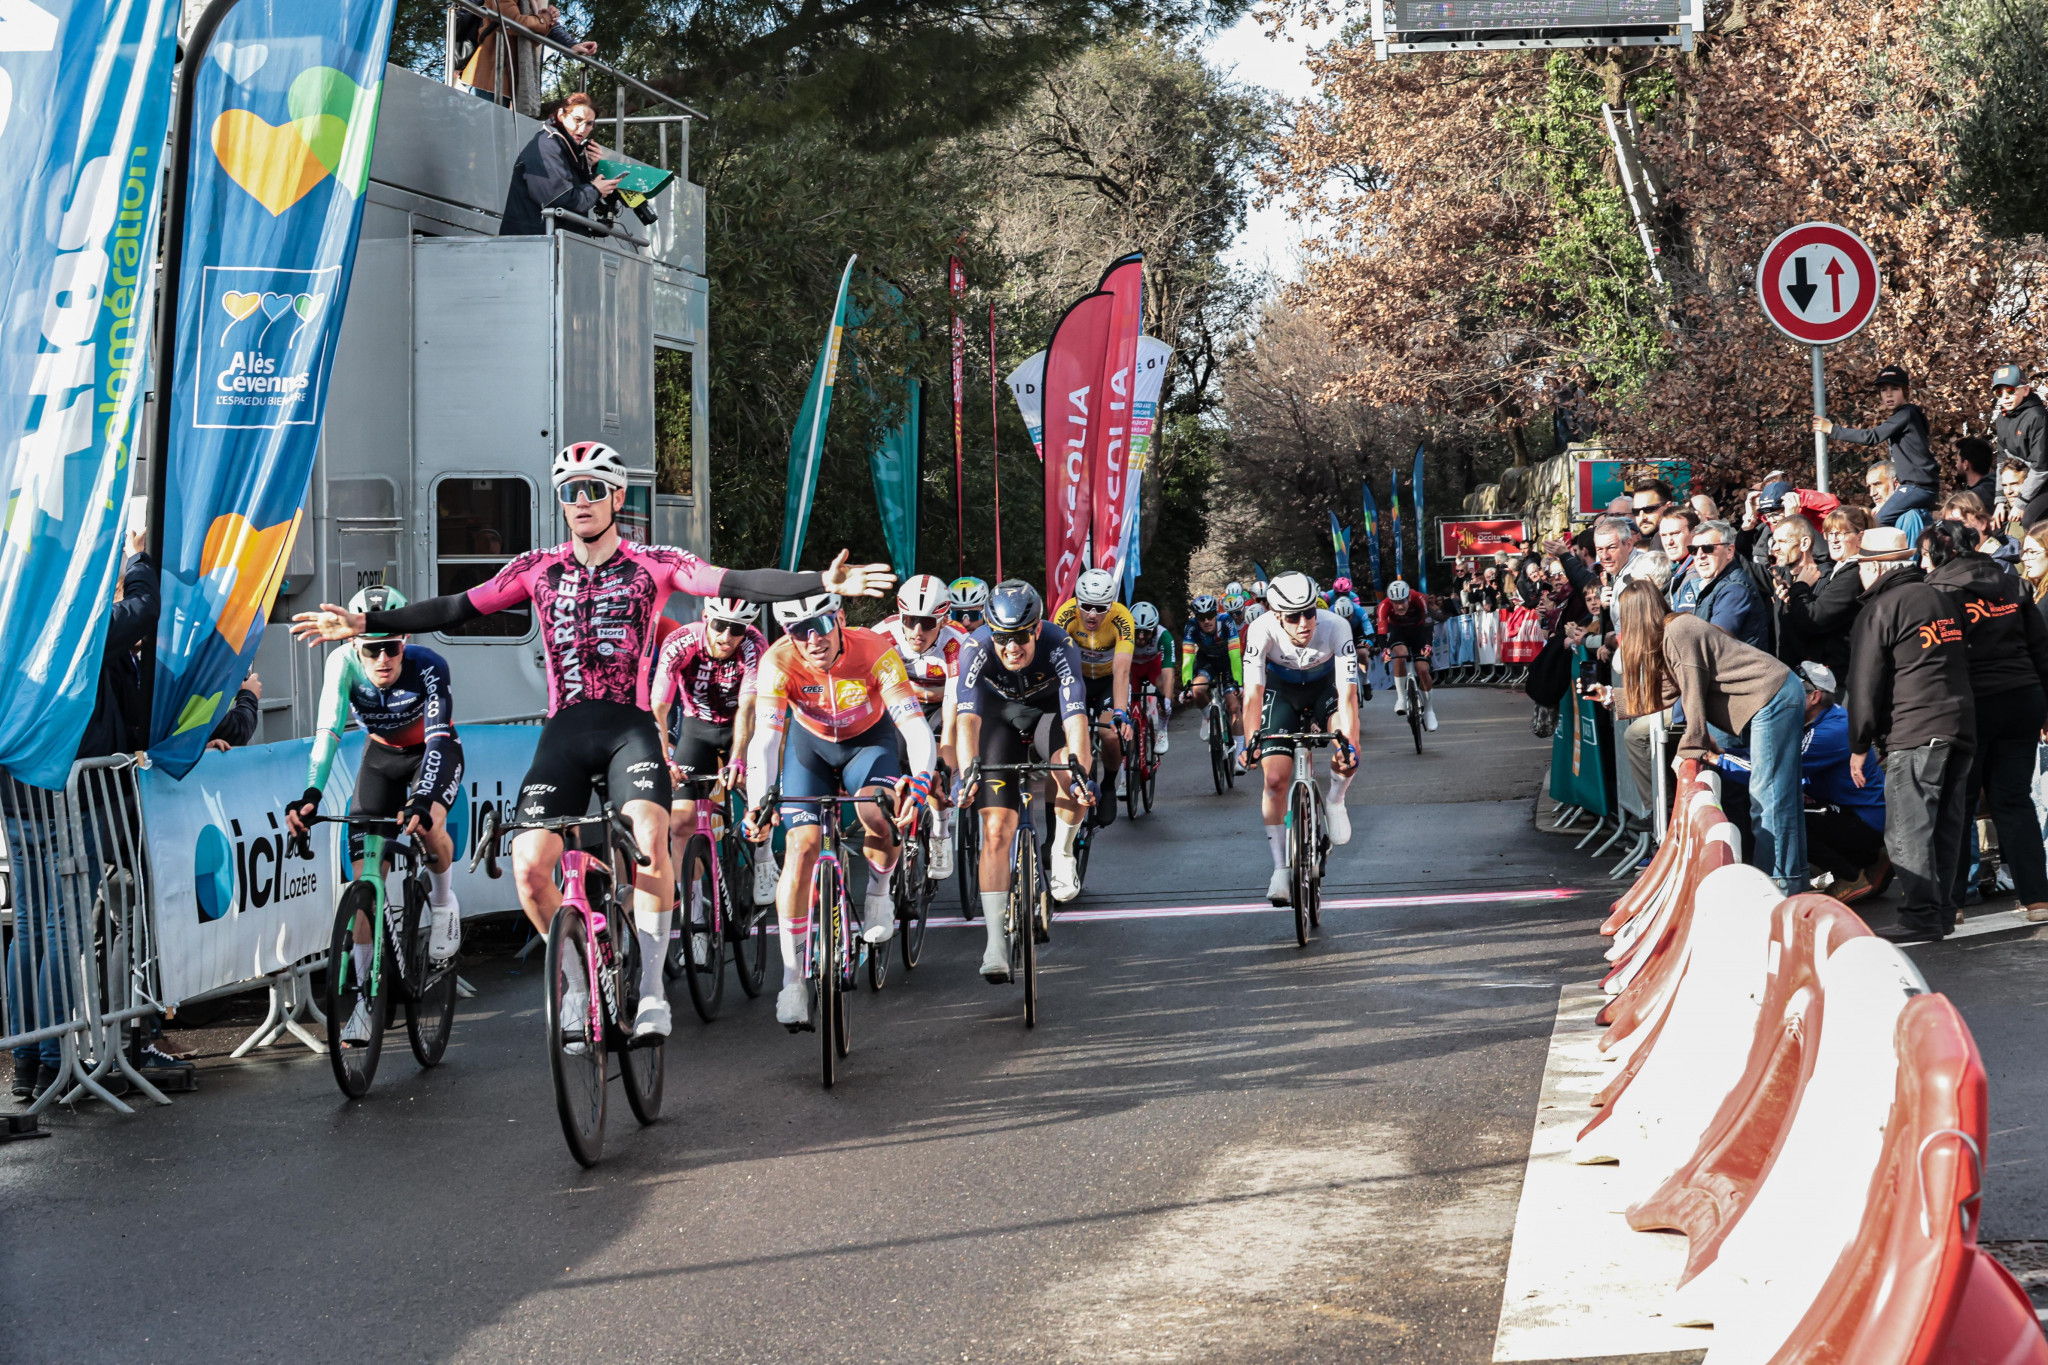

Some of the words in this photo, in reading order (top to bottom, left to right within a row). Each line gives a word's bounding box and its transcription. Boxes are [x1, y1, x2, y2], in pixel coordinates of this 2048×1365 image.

[229, 351, 275, 374] Alès
[553, 569, 580, 644] RYSEL
[600, 629, 625, 637] Nord
[1112, 614, 1132, 641] MAURIN
[561, 647, 584, 701] VAN
[1054, 656, 1076, 687] UBS
[419, 665, 441, 718] Adecco
[1065, 701, 1085, 712] SGS
[230, 812, 284, 914] ici
[284, 867, 317, 900] Lozère
